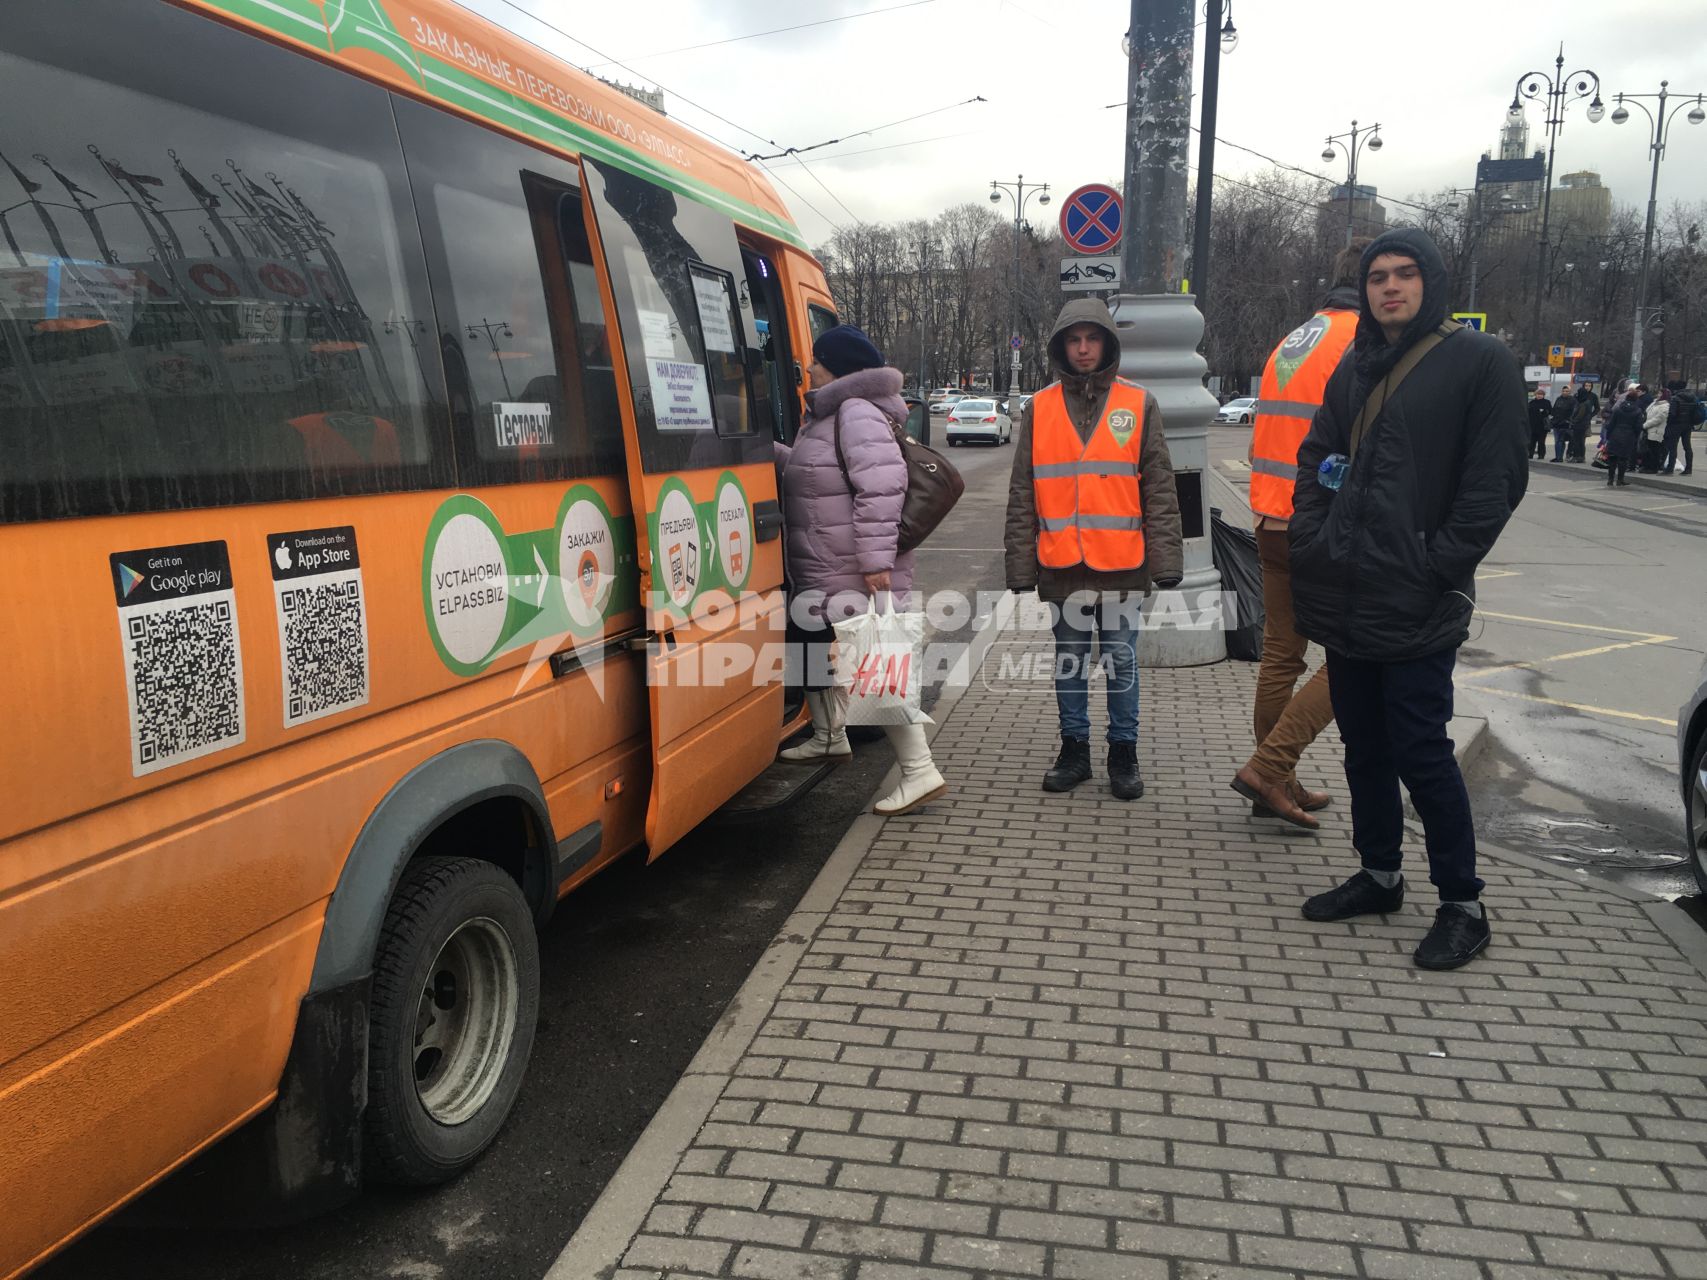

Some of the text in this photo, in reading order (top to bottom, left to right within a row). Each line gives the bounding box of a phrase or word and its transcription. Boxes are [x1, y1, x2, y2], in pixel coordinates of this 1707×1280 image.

[410, 16, 516, 86] ЗАКАЗНЫЕ
[516, 68, 607, 129] ПЕРЕВОЗКИ
[607, 117, 637, 143] ООО
[1284, 327, 1323, 348] ЭЛ
[493, 403, 552, 446] Тестовый
[1111, 415, 1133, 428] ЭЛ
[720, 507, 745, 523] ПОЕХАЛИ
[660, 517, 696, 537] ПРЕДЪЯВИ
[295, 534, 346, 549] Download on the
[567, 529, 605, 549] ЗАКАЖИ
[148, 557, 183, 569] Get it on
[298, 549, 350, 570] App Store
[150, 568, 222, 594] Google play
[436, 563, 502, 590] УСТАНОВИ
[439, 586, 504, 616] ELPASS.BIZ
[849, 653, 911, 699] H&M
